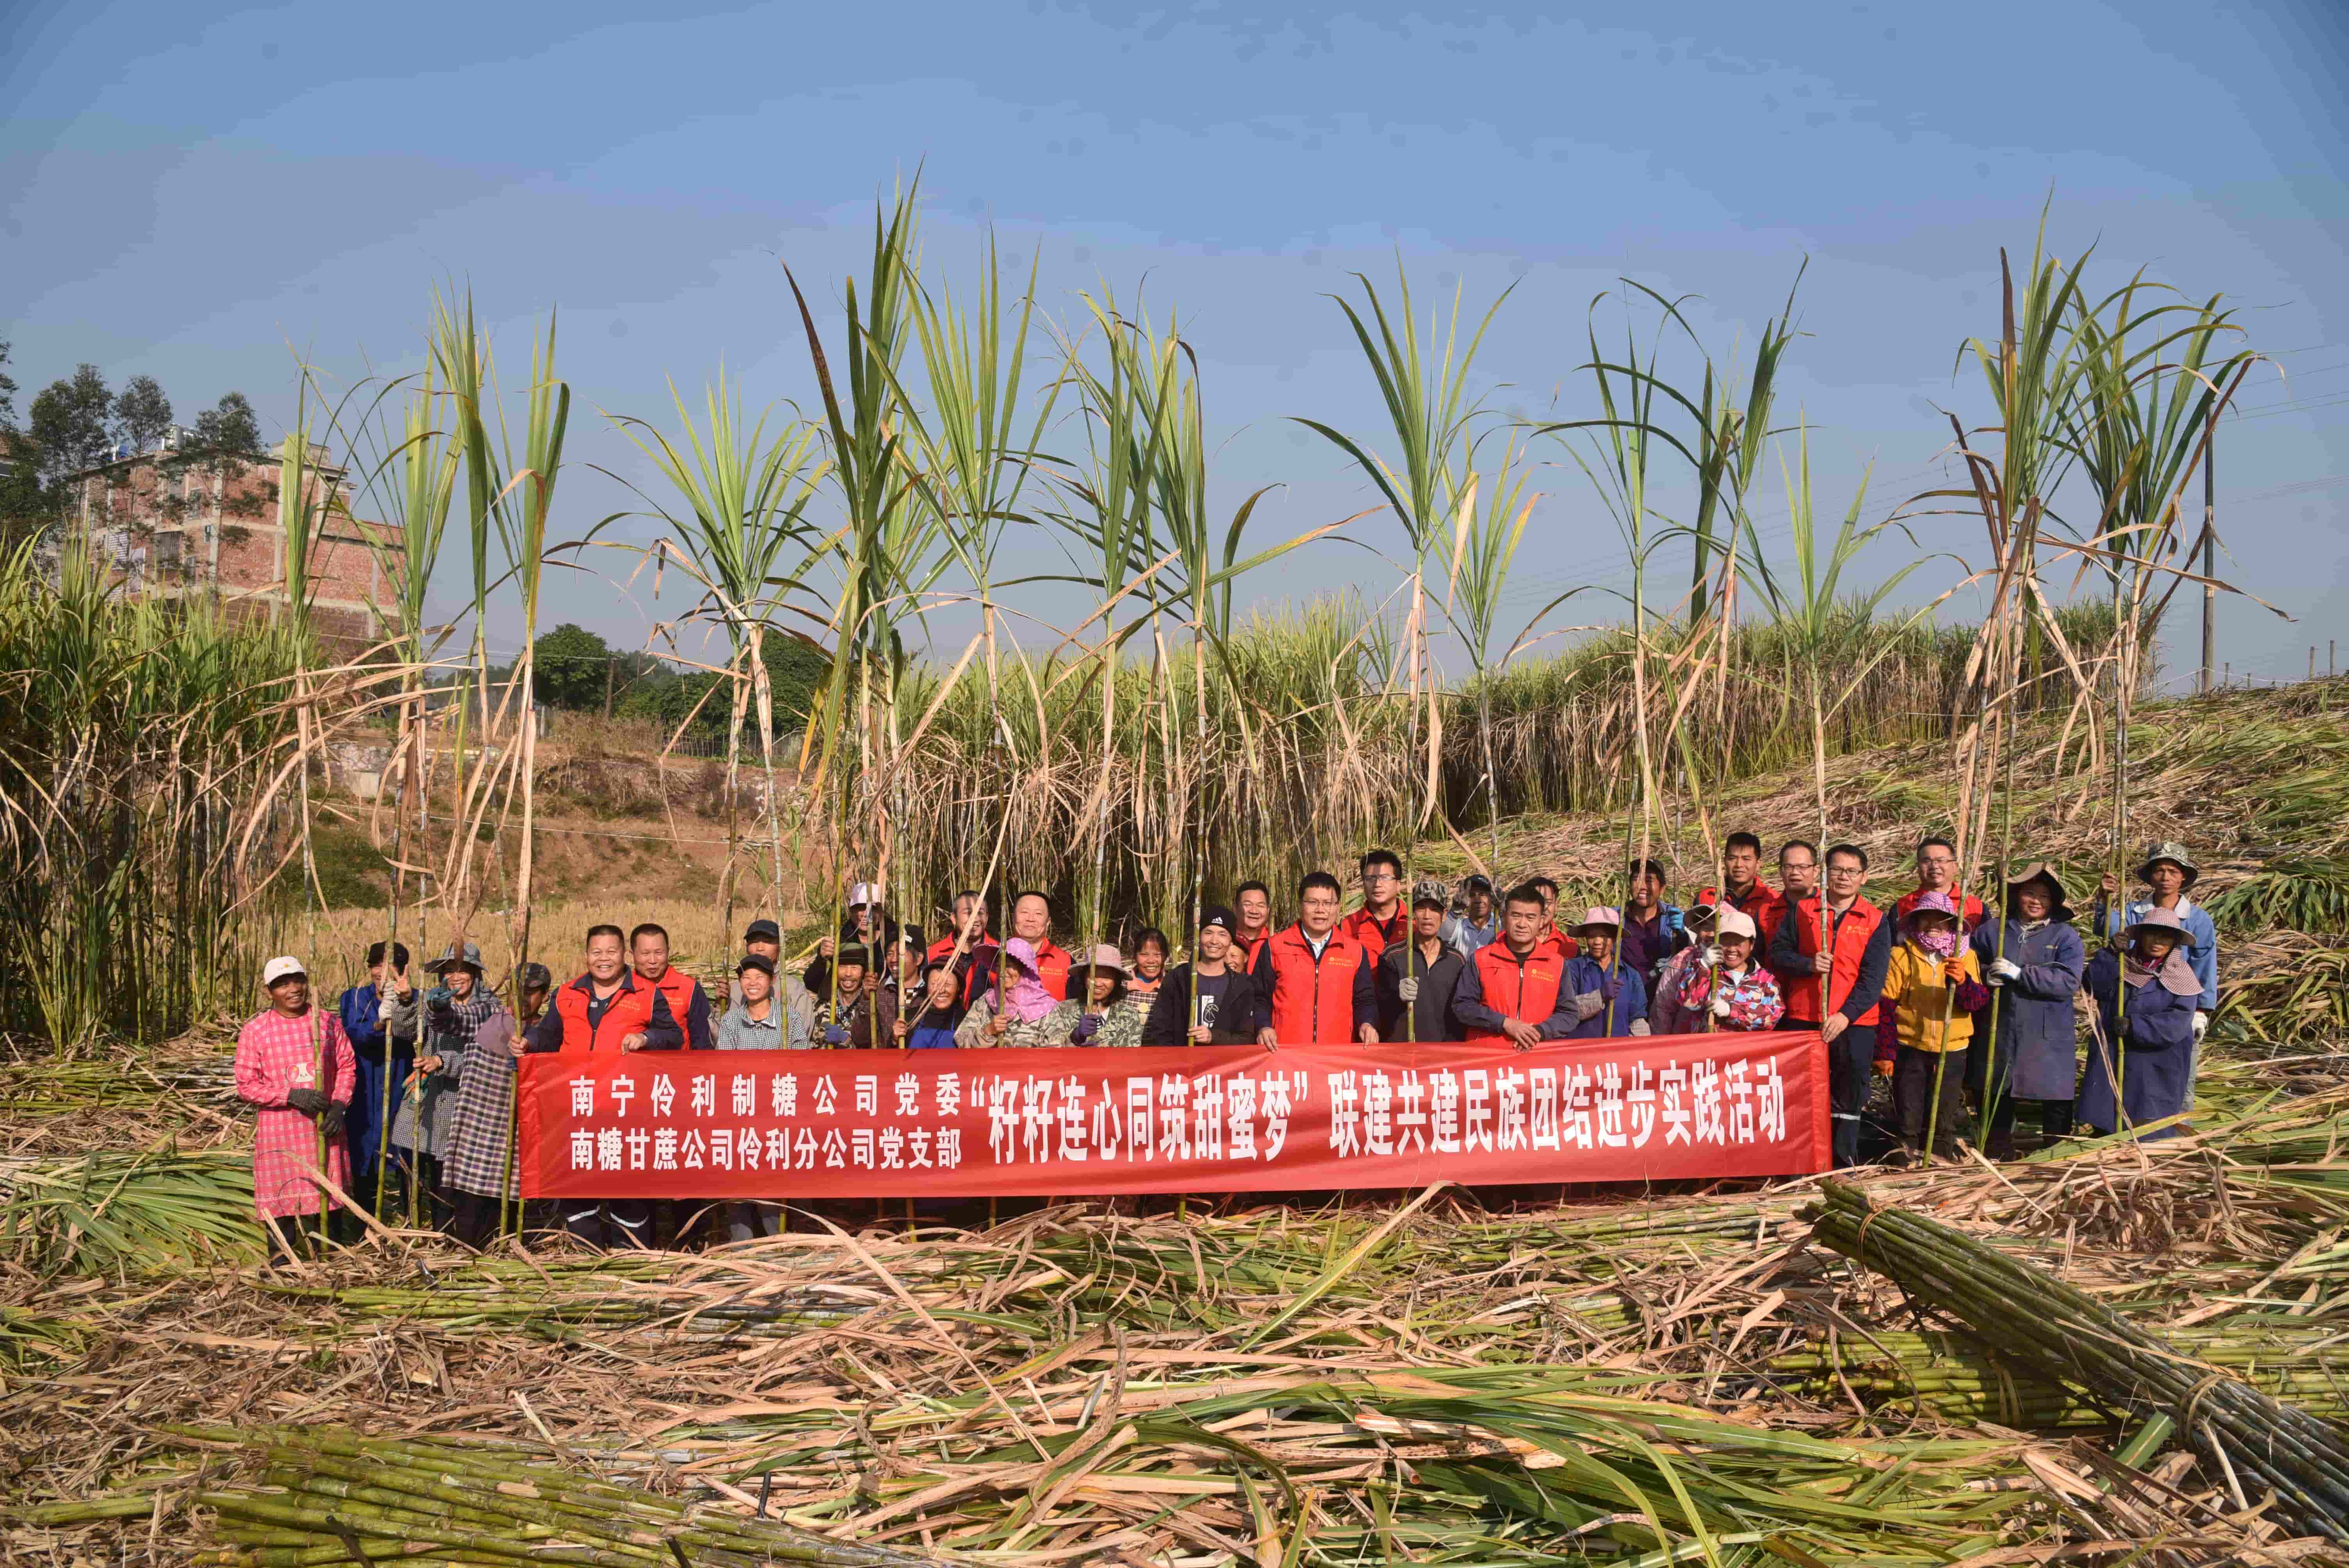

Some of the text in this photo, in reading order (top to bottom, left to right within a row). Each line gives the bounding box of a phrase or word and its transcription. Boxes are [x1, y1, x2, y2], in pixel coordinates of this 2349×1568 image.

[569, 1072, 961, 1117] 南宁伶利制糖公司党委
[971, 1055, 1786, 1164] “籽籽连心同筑甜蜜梦” 联建共建民族团结进步实践活动
[570, 1126, 961, 1171] 南糖甘蔗公司伶利分公司党支部
